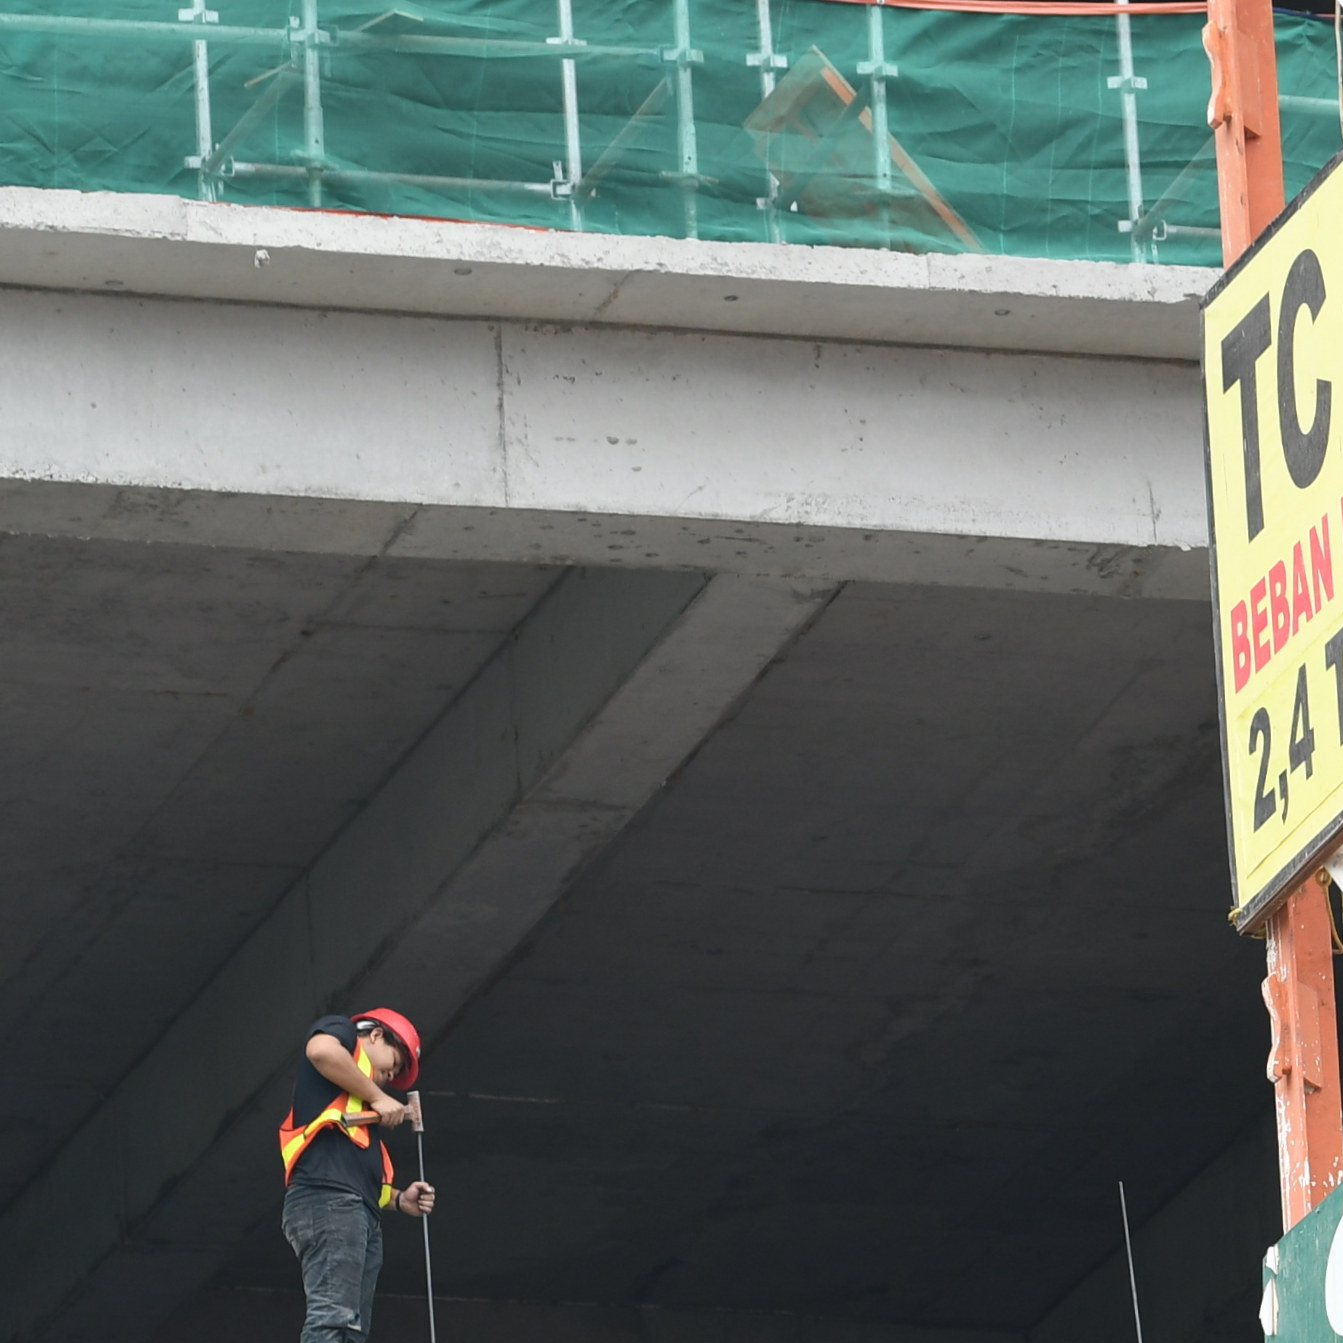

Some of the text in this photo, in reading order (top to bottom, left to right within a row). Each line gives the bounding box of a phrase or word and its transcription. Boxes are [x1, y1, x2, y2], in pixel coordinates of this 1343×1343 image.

[1222, 248, 1332, 542] TC
[1229, 512, 1335, 694] BEBAN
[1246, 664, 1315, 834] 2,4
